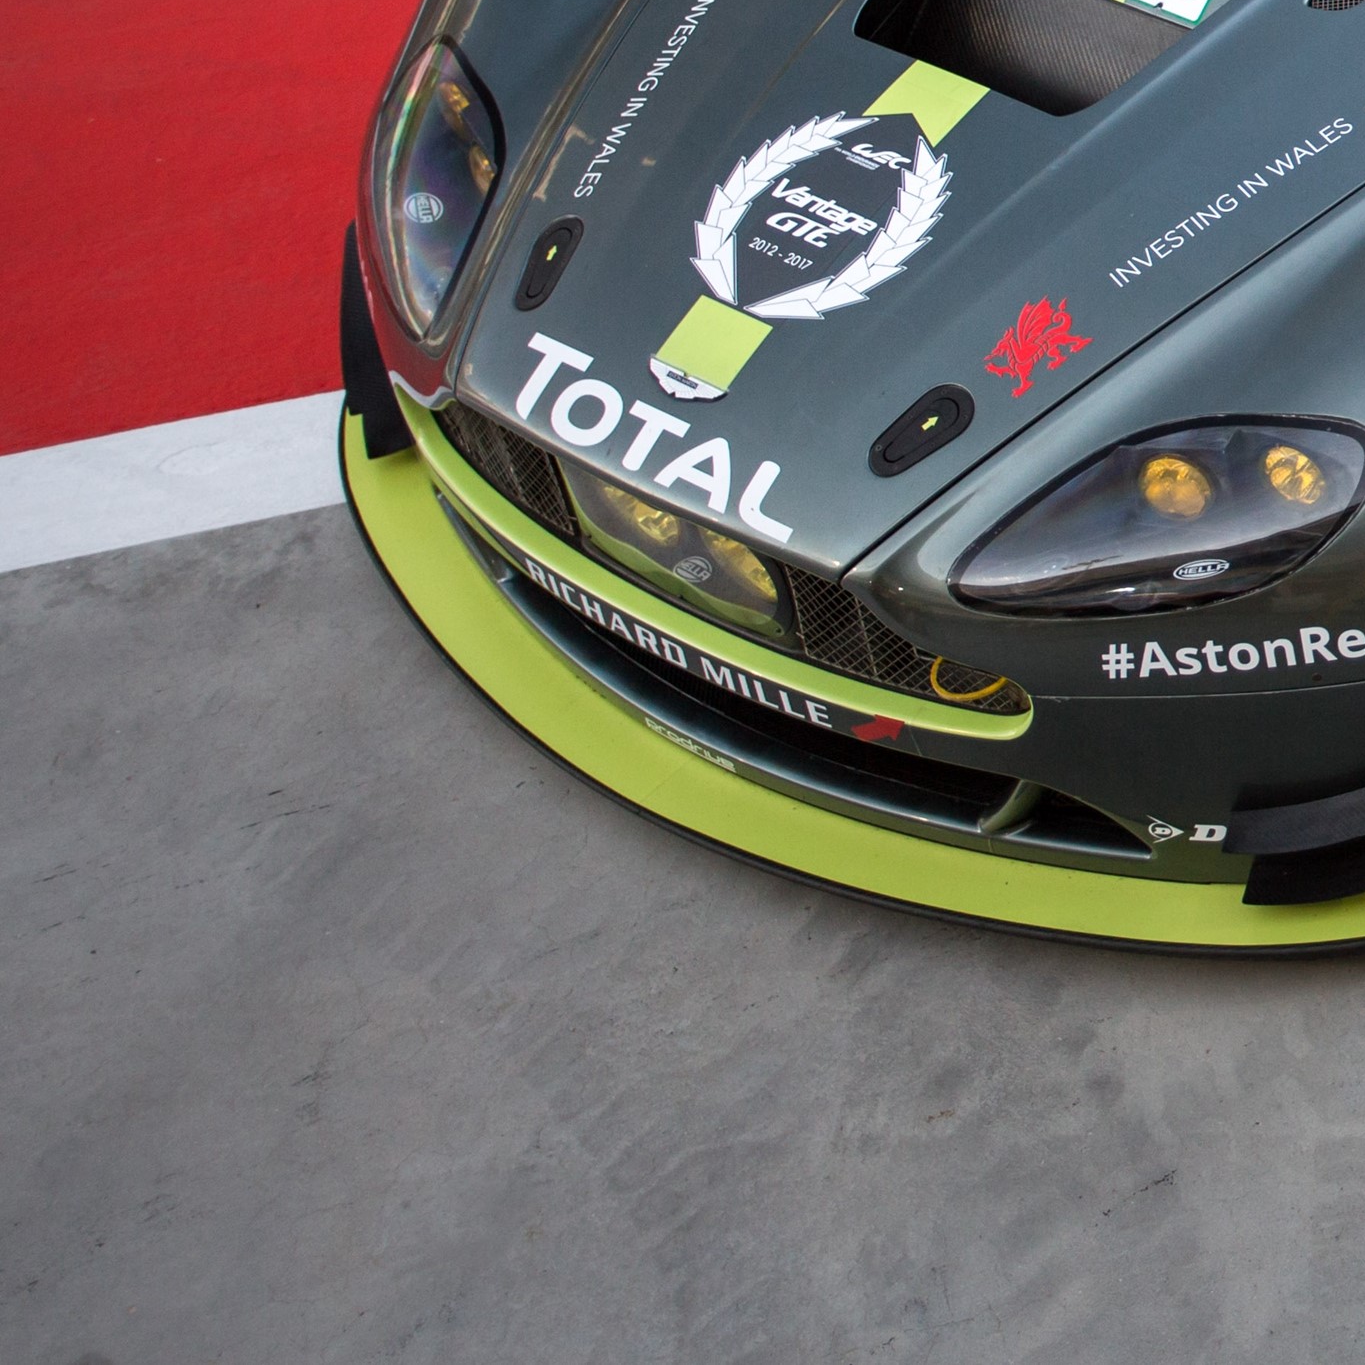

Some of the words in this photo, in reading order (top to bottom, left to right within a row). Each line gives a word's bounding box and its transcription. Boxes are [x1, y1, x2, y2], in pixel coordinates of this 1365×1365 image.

[620, 97, 647, 117] IN
[573, 122, 632, 198] WALES
[851, 143, 912, 170] WEC
[771, 178, 878, 236] Vantage
[1109, 193, 1239, 288] INVESTING
[1237, 172, 1269, 198] IN
[1265, 117, 1353, 177] WALES
[748, 237, 779, 258] 2012
[783, 252, 814, 270] 2017
[766, 212, 841, 248] GTE
[515, 332, 794, 544] TOTAL
[1175, 560, 1230, 580] HELLA
[525, 558, 688, 669] RICHARD
[701, 658, 833, 728] MILLE
